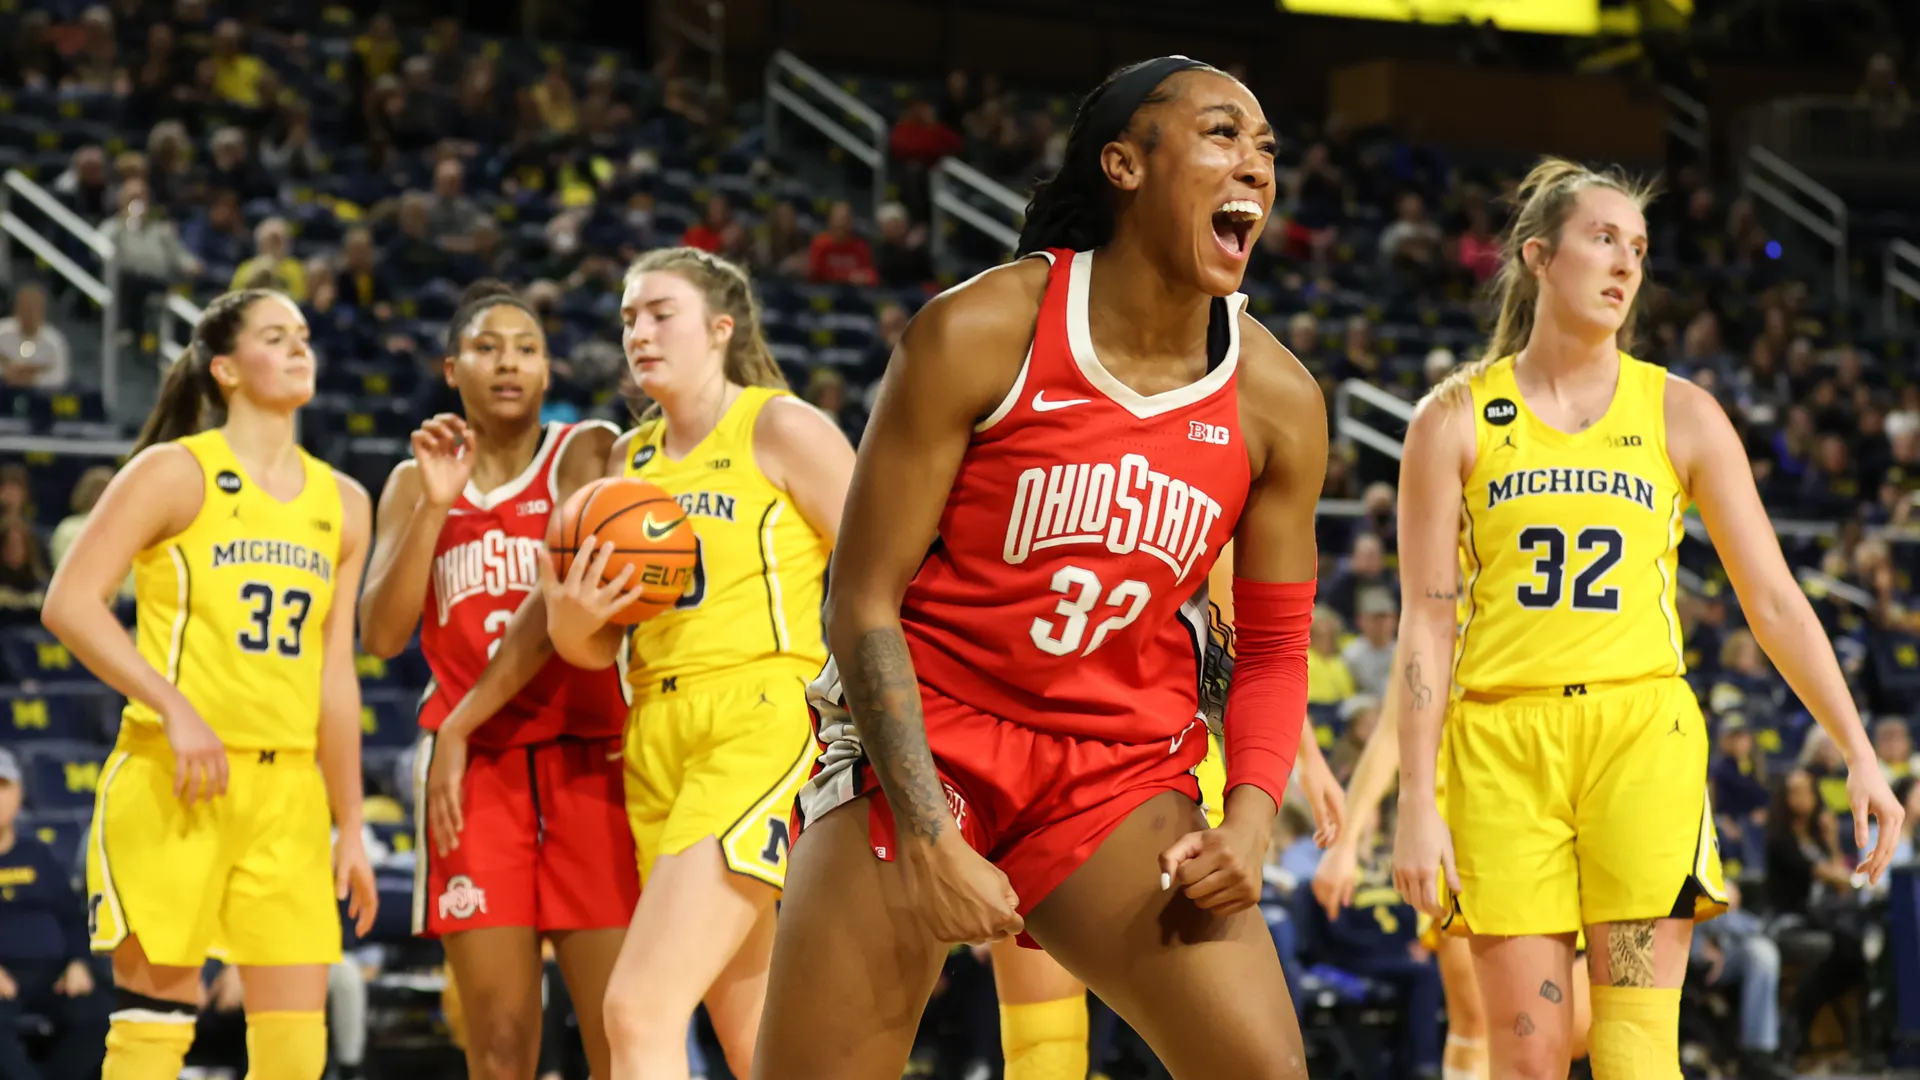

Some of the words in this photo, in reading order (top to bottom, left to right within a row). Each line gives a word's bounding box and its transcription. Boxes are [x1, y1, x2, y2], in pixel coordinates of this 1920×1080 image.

[1486, 405, 1515, 419] BLM
[1487, 468, 1655, 512] MICHIGAN
[212, 540, 332, 585] MICHIGAN
[1516, 524, 1624, 612] 32
[239, 581, 312, 658] 33
[1029, 565, 1152, 658] 32
